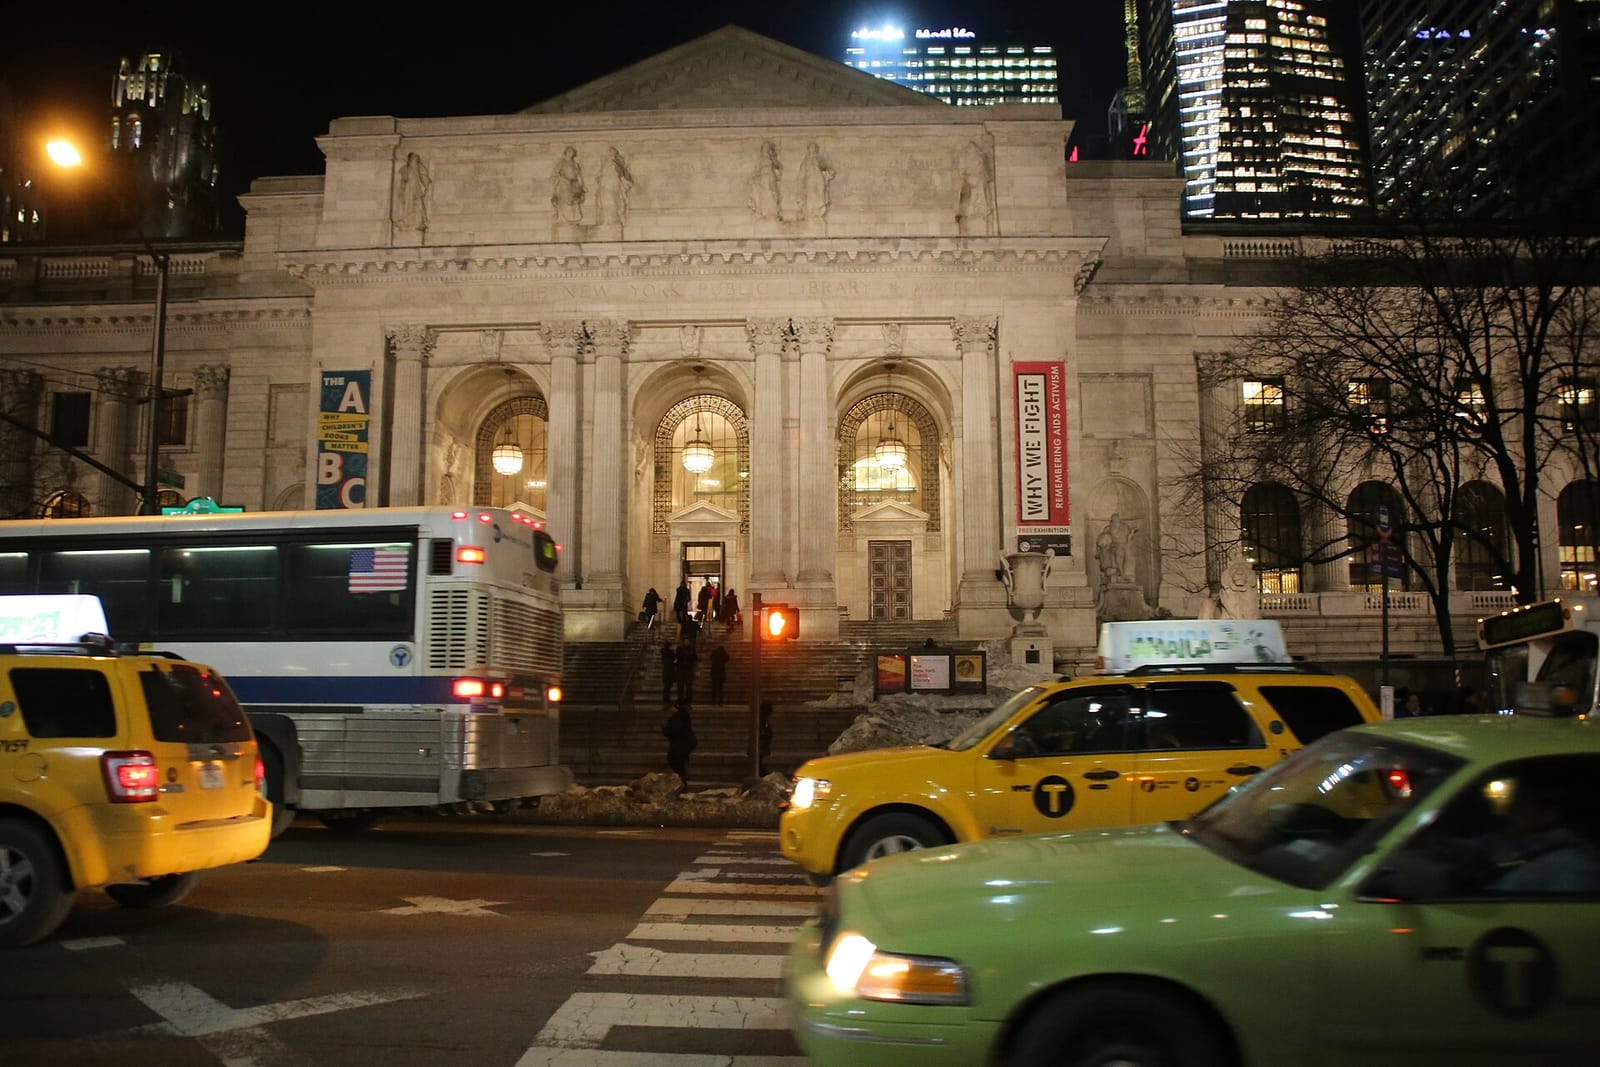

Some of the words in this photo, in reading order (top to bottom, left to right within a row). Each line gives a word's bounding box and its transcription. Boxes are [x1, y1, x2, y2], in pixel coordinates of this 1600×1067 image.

[323, 377, 345, 386] THE
[338, 381, 366, 413] A
[1050, 365, 1061, 411] ACTIVISM
[1023, 379, 1041, 434] FIGHT
[321, 423, 363, 431] CHILDREN'S
[1052, 412, 1062, 436] AIDS
[318, 452, 342, 485] B
[1025, 440, 1041, 468] WE
[1053, 438, 1064, 509] REMEMBERING
[340, 477, 365, 510] C
[1026, 473, 1043, 516] WHY
[1041, 783, 1068, 813] T
